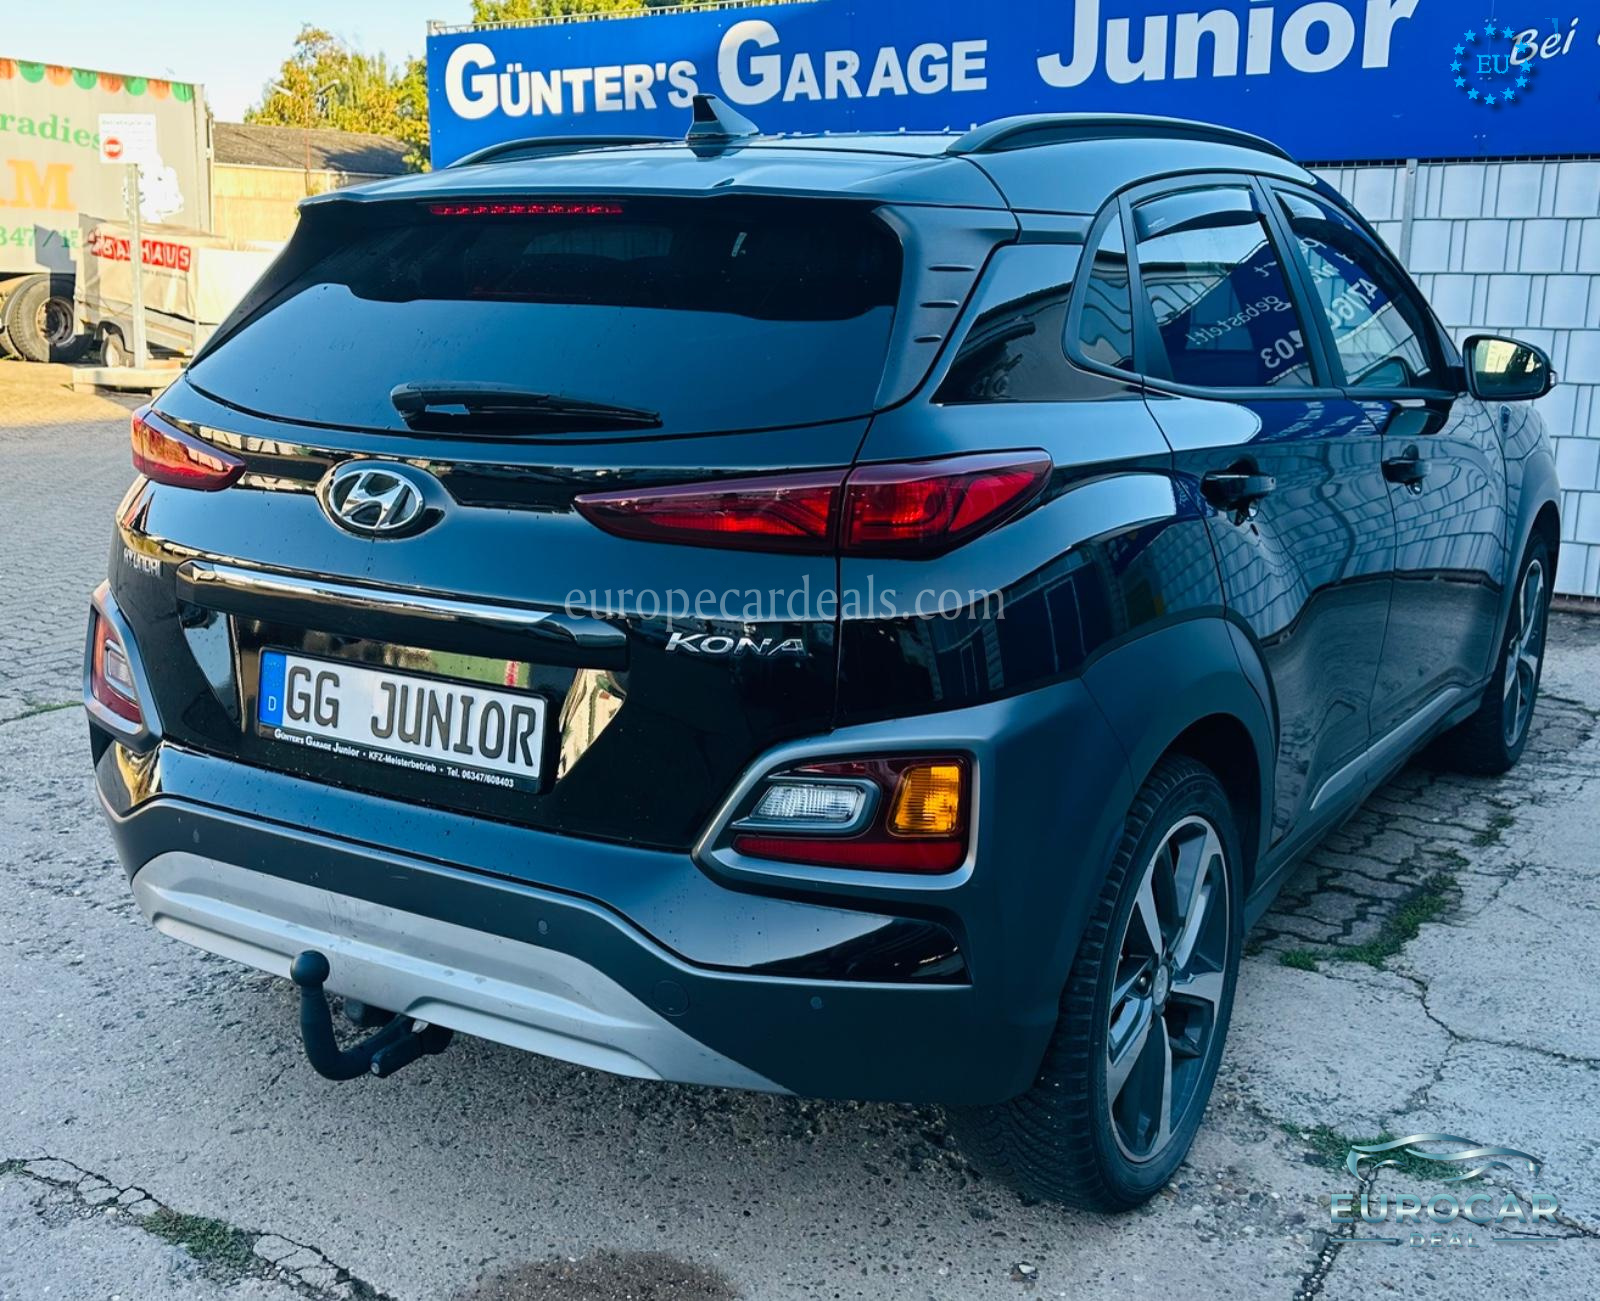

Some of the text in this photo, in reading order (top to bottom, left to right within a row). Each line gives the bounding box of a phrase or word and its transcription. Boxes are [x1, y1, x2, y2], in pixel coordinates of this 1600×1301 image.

[445, 0, 1419, 120] GÜNTER'S GARAGE Junior
[1509, 17, 1579, 66] Bei
[0, 159, 76, 212] M
[102, 235, 191, 272] BAHAUS
[665, 632, 808, 656] KONA
[286, 665, 537, 767] GG JUNIOR
[333, 742, 360, 757] Junior
[368, 751, 437, 773] KFZ-Meisterbetrieb
[446, 766, 460, 778] Tel.
